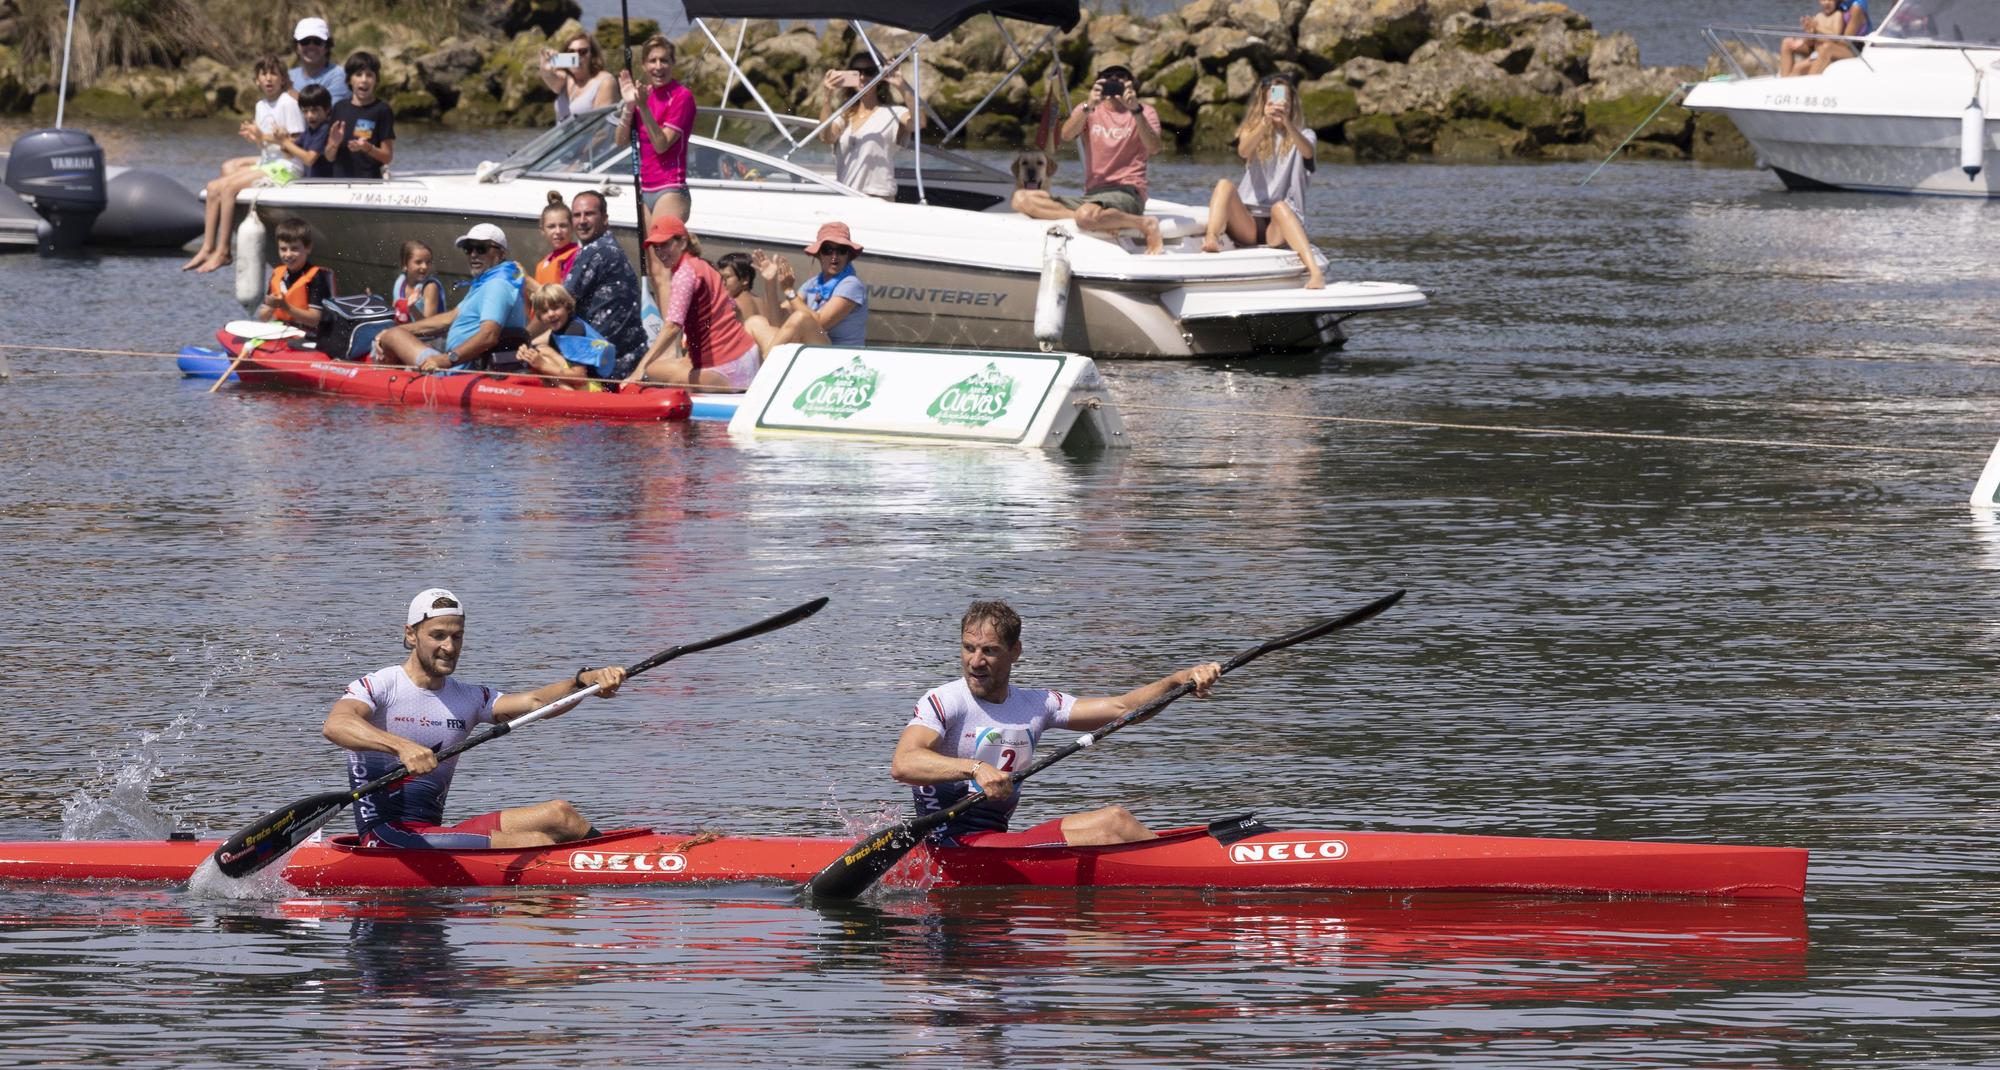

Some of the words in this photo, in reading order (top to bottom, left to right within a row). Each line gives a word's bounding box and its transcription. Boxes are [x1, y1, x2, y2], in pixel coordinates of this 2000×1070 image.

[50, 156, 96, 171] YAMAHA
[866, 284, 1008, 307] MONTEREY
[1000, 748, 1017, 773] 2
[1240, 816, 1258, 829] FRA
[1233, 841, 1345, 861] NELO
[573, 853, 684, 871] NELO
